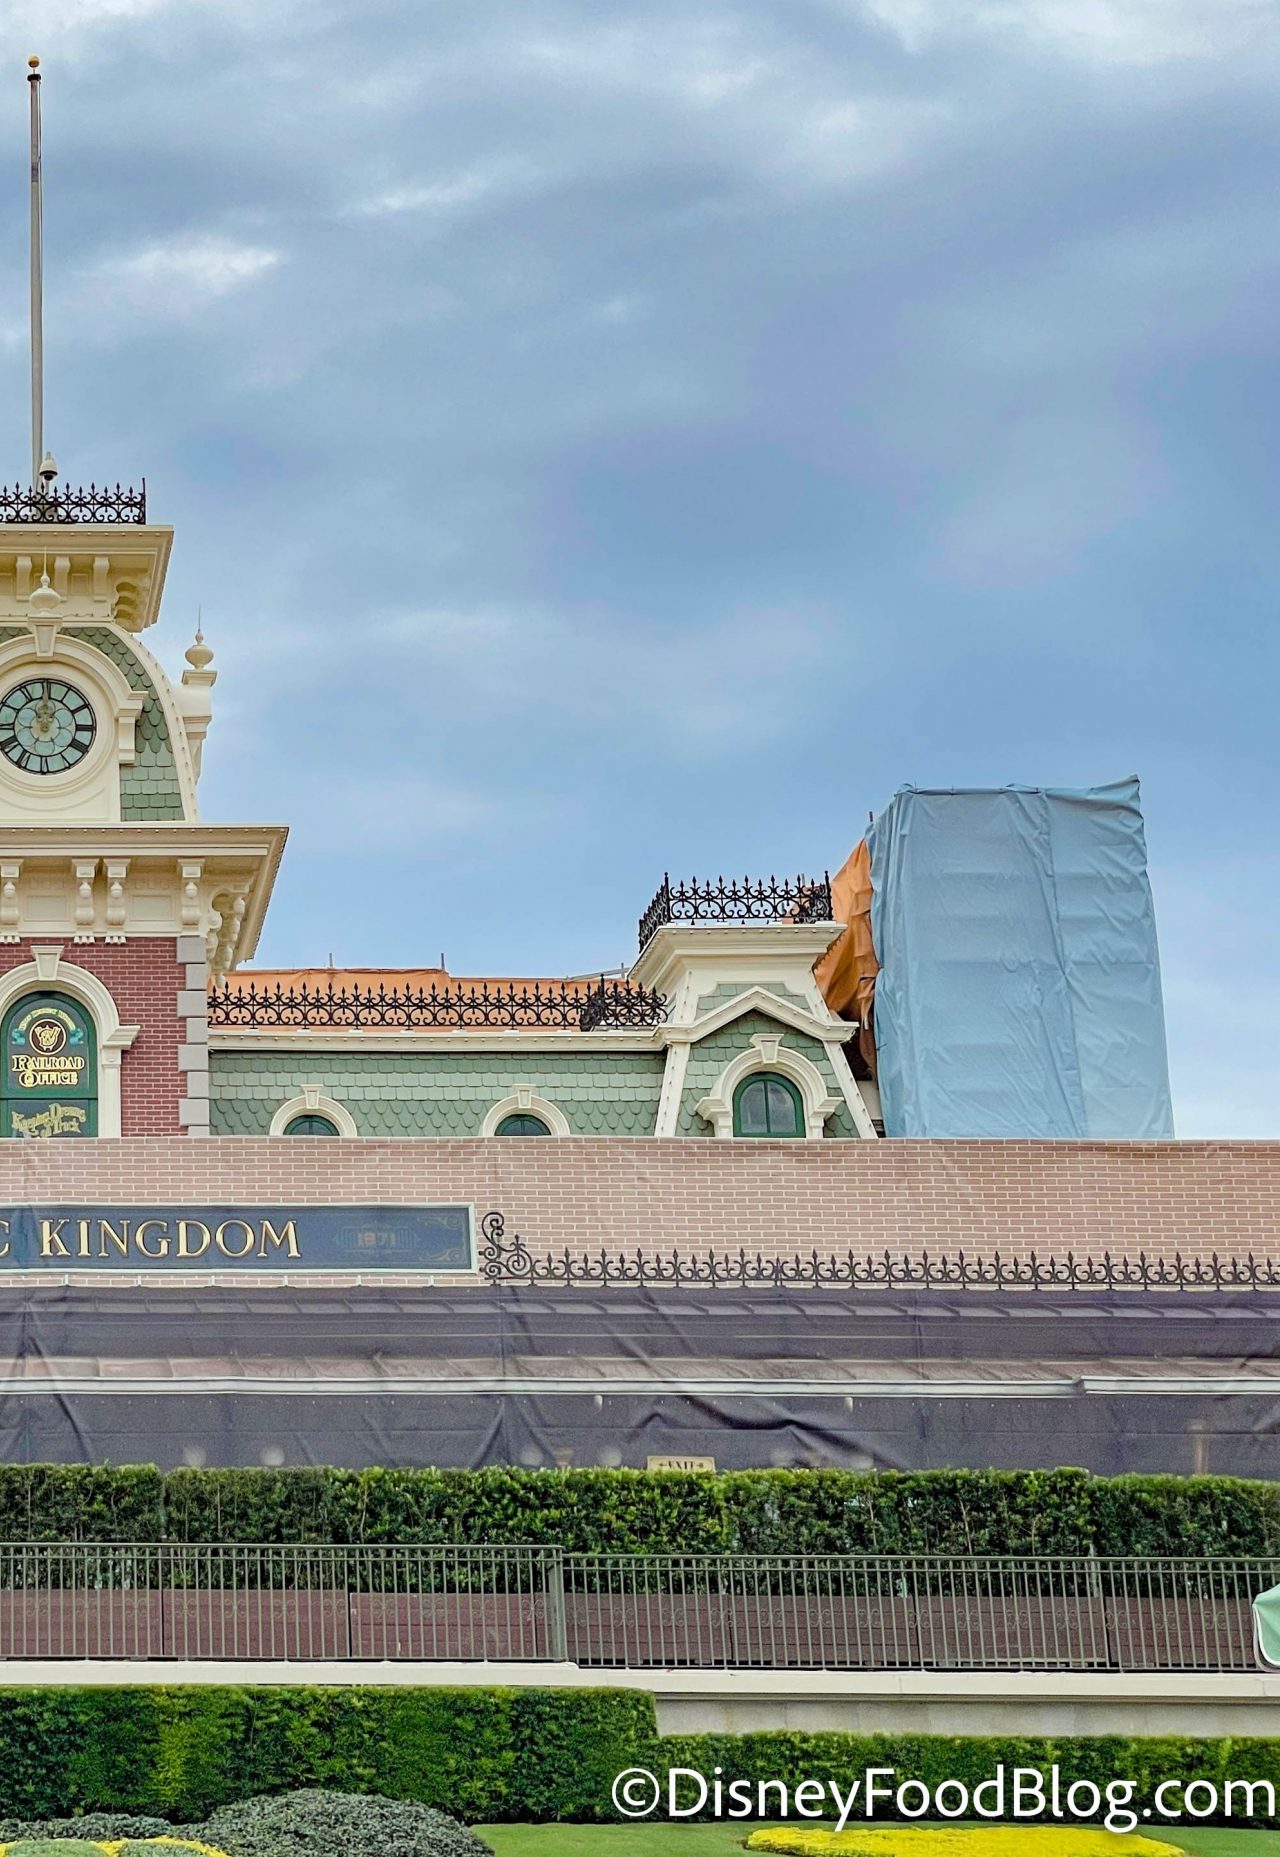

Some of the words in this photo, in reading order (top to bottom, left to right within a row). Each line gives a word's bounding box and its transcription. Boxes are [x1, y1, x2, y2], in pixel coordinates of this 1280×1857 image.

[11, 1054, 86, 1072] RAILROAD
[18, 1071, 79, 1088] OFFICE
[38, 1218, 302, 1258] KINGDOM
